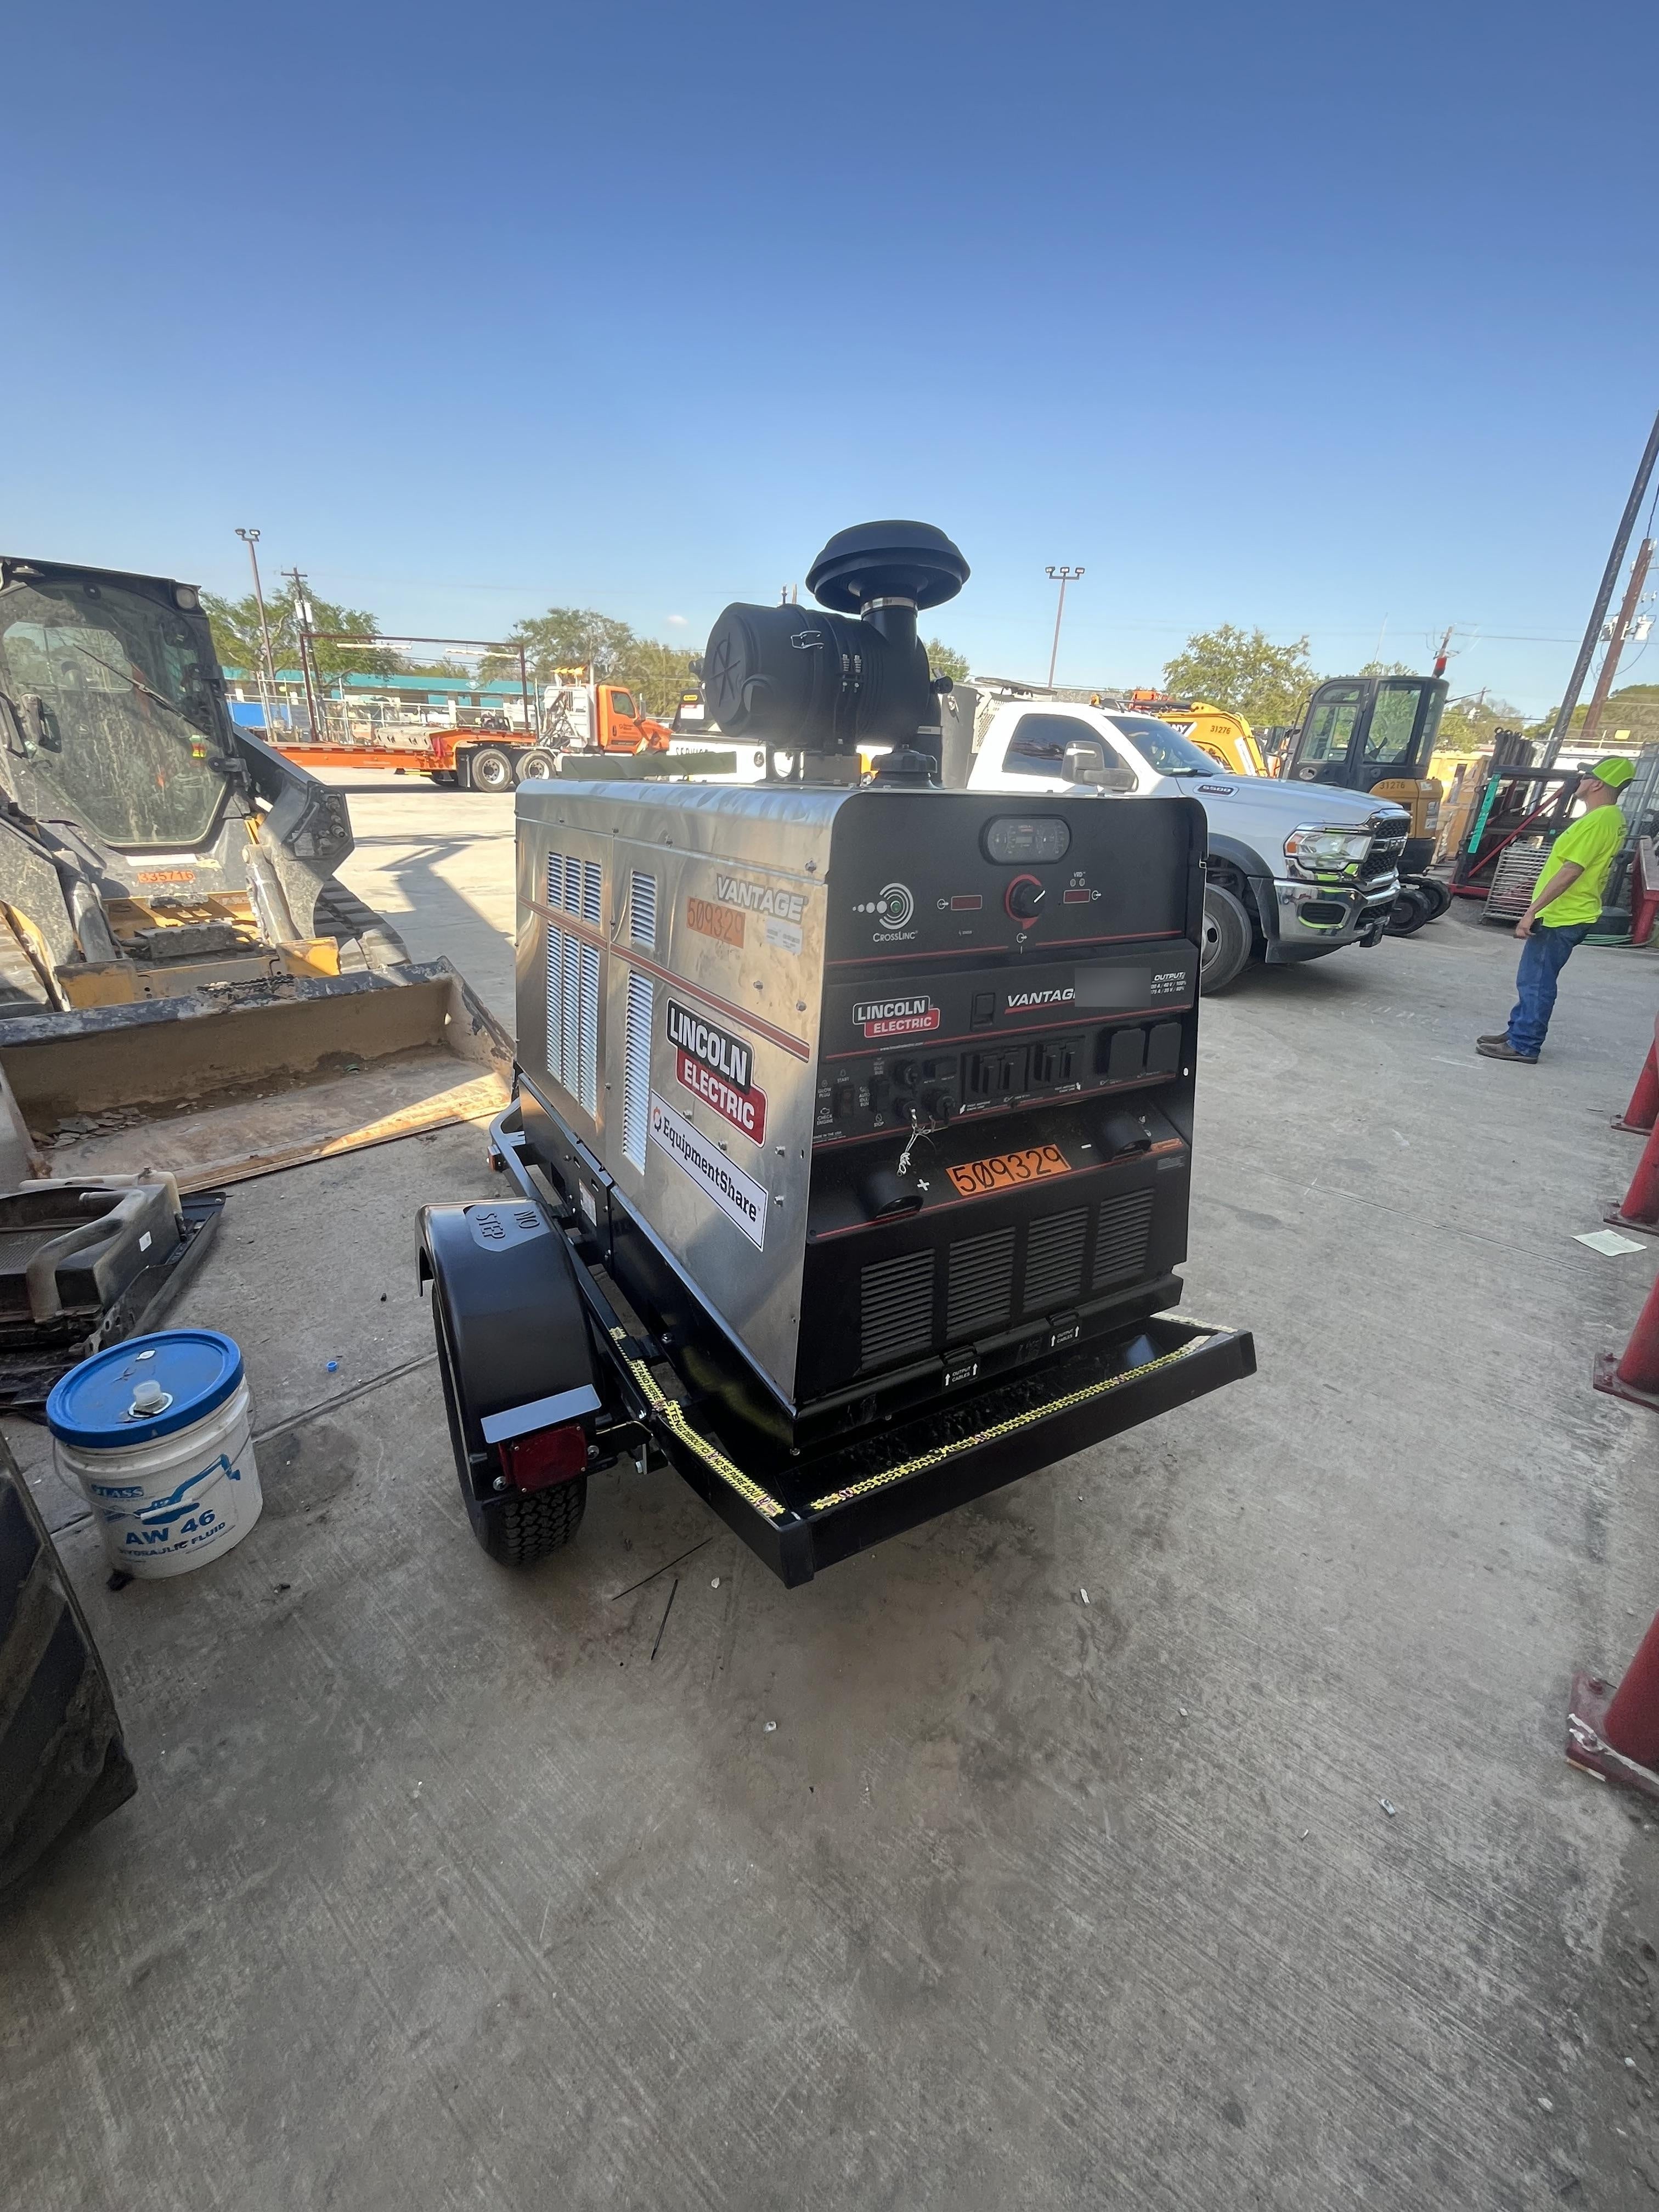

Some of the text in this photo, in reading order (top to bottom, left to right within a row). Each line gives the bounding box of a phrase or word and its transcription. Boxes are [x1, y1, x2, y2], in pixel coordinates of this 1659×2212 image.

[1210, 725, 1231, 735] 31276
[1379, 781, 1405, 789] 31276
[717, 876, 805, 922] VANTAGE
[687, 898, 745, 945] 509329
[1154, 972, 1184, 981] OUTPUT
[1007, 988, 1075, 1007] VANTAG
[857, 1000, 926, 1021] LINCOLN
[873, 1016, 932, 1034] ELECTRIC
[670, 1007, 747, 1086] LINCOLN
[684, 1058, 755, 1130] ELECTRIC
[663, 1116, 757, 1222] EquipmentShare
[952, 1146, 1069, 1193] 509329
[476, 1212, 506, 1239] STEP
[514, 1210, 540, 1229] NO
[634, 1361, 650, 1386] STAND
[647, 1382, 661, 1401] HERE
[952, 1366, 971, 1376] OUTPUT
[952, 1372, 970, 1382] CABLES
[713, 1458, 725, 1466] NO
[720, 1464, 732, 1473] SE
[729, 1471, 747, 1486] PARE
[854, 1481, 874, 1491] DO
[876, 1469, 902, 1482] NOT
[125, 1527, 169, 1545] AW
[180, 1509, 216, 1534] 46
[191, 1522, 226, 1544] FLUID
